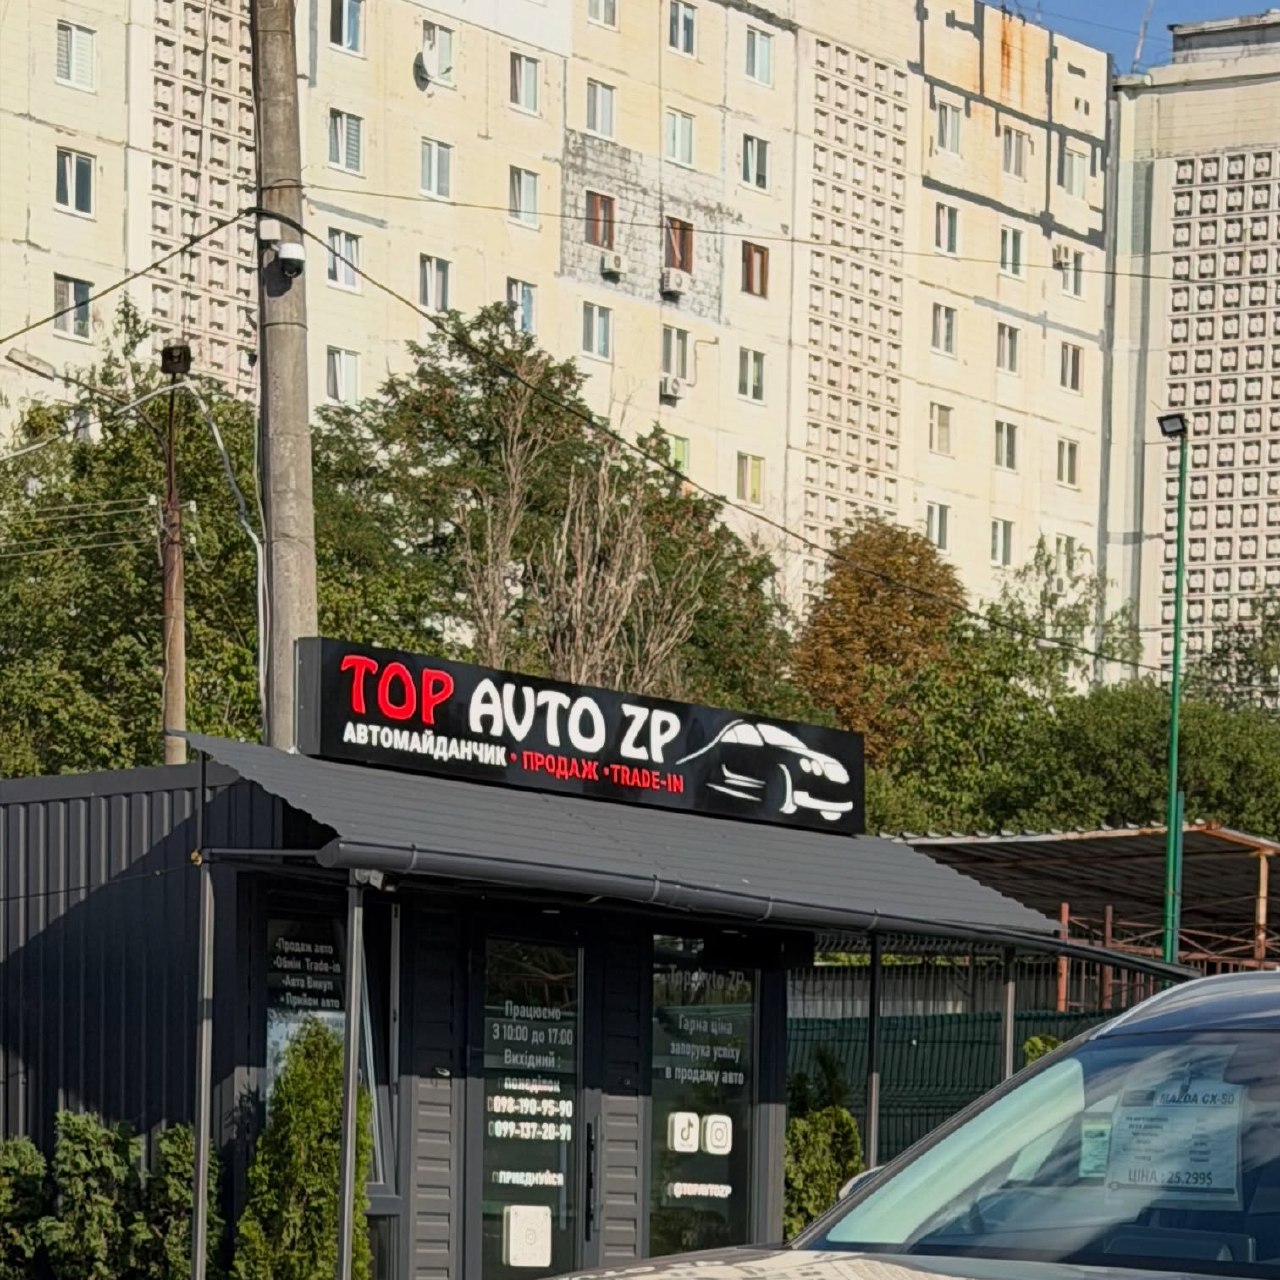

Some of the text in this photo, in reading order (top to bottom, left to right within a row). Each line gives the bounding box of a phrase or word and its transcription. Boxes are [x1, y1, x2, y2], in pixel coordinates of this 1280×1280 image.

[341, 655, 681, 763] TOP AVTO ZP
[343, 721, 684, 793] АВТОМАЙДАНЧИК ПРОДАЖ TRADE-IN
[502, 1023, 529, 1042] 10:00
[531, 1030, 545, 1046] до
[548, 1027, 574, 1046] 17:00
[504, 1048, 556, 1069] Вихідний
[674, 1067, 720, 1087] продажу
[721, 1070, 744, 1085] авто
